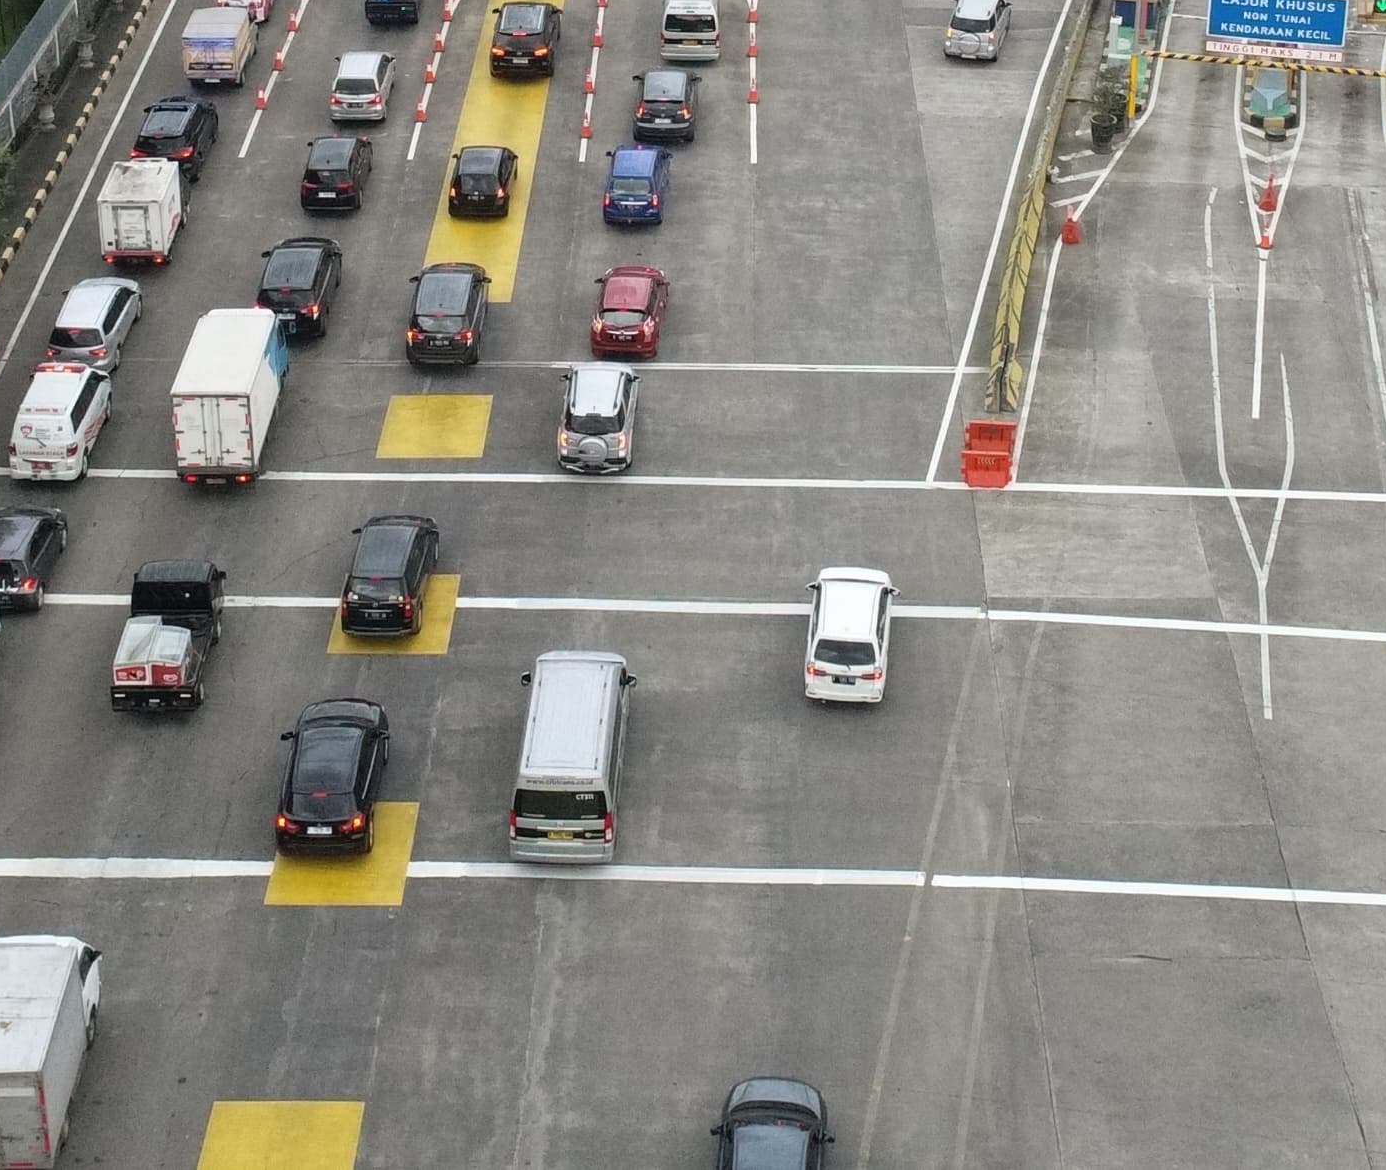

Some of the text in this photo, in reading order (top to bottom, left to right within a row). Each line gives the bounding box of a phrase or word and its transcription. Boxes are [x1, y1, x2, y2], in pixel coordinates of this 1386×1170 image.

[1243, 11, 1311, 25] NON TUNAI
[1220, 22, 1331, 40] KENDARAAN KECIL
[1212, 42, 1255, 53] TINGGI
